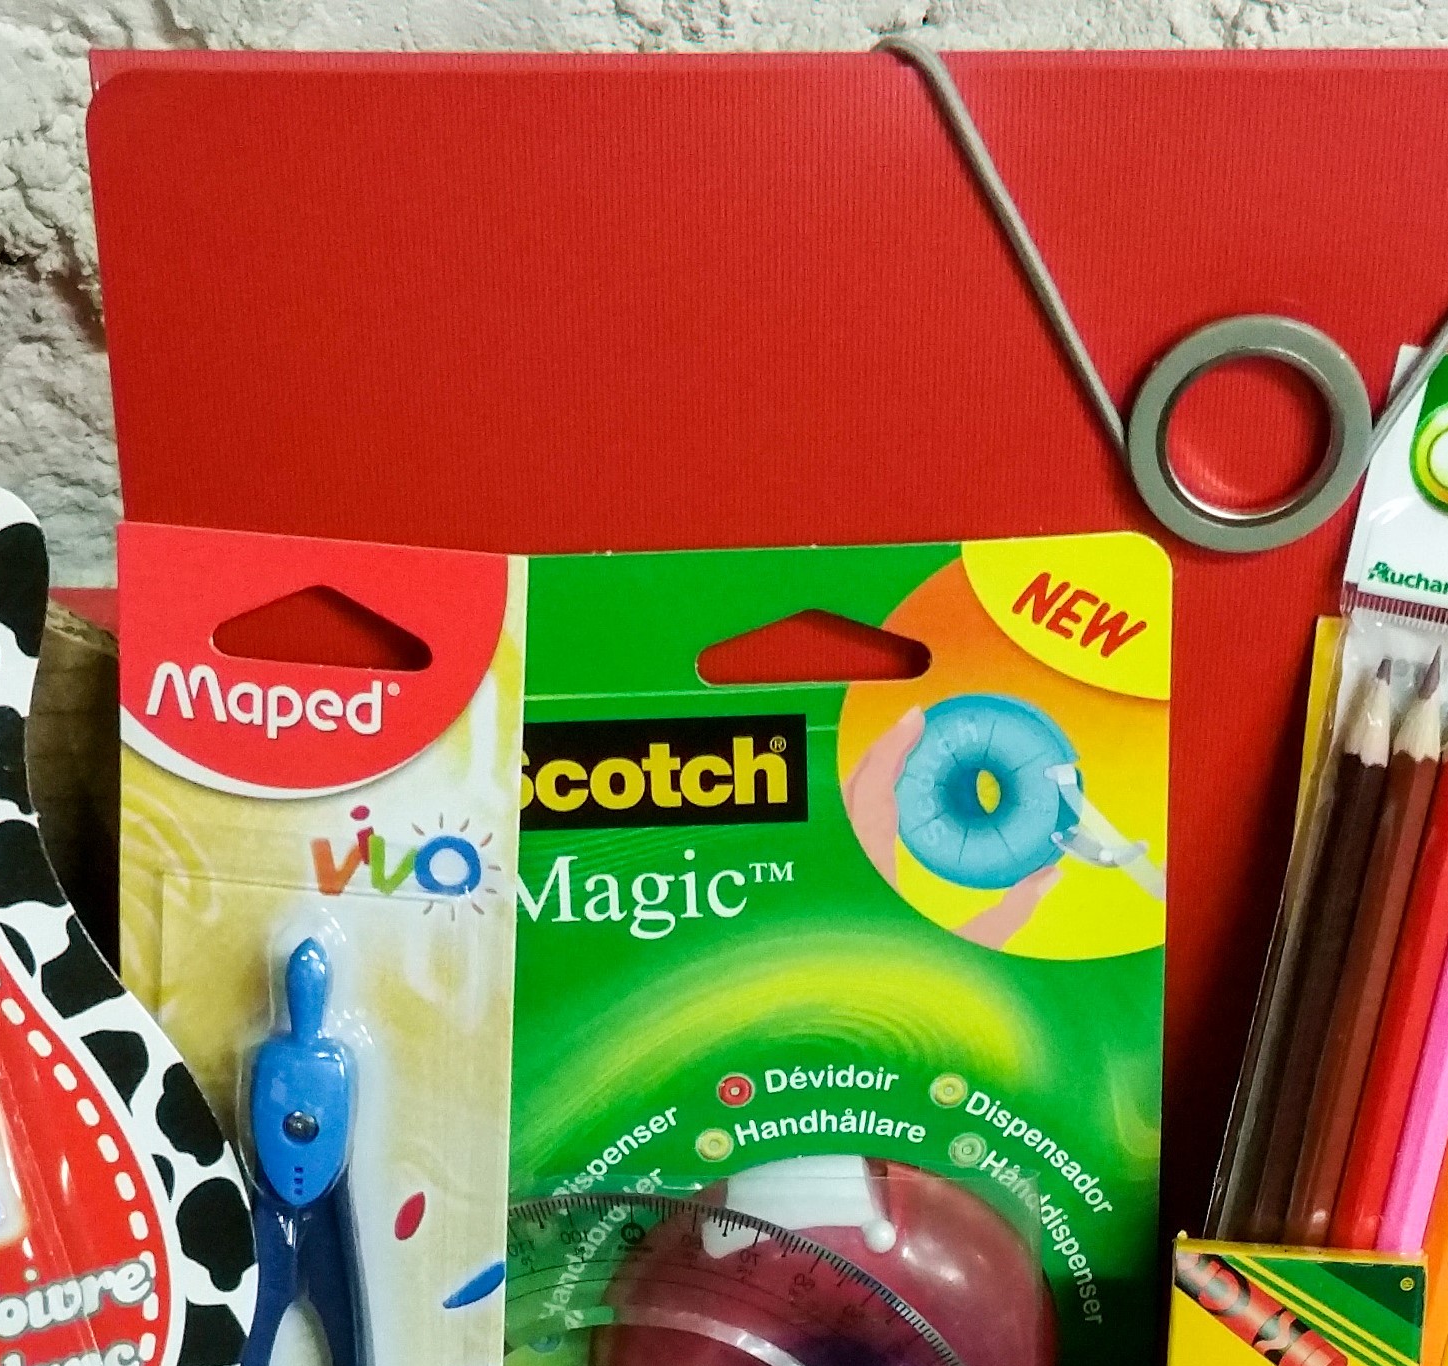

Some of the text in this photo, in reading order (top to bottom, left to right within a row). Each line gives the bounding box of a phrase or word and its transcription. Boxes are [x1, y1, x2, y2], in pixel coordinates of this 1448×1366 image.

[1011, 571, 1147, 658] NEW
[145, 661, 383, 740] Maped
[310, 805, 481, 896] vivo
[734, 1109, 927, 1148] Handhållare
[764, 1065, 900, 1097] Dévidoir
[965, 1090, 1115, 1217] Dispensador
